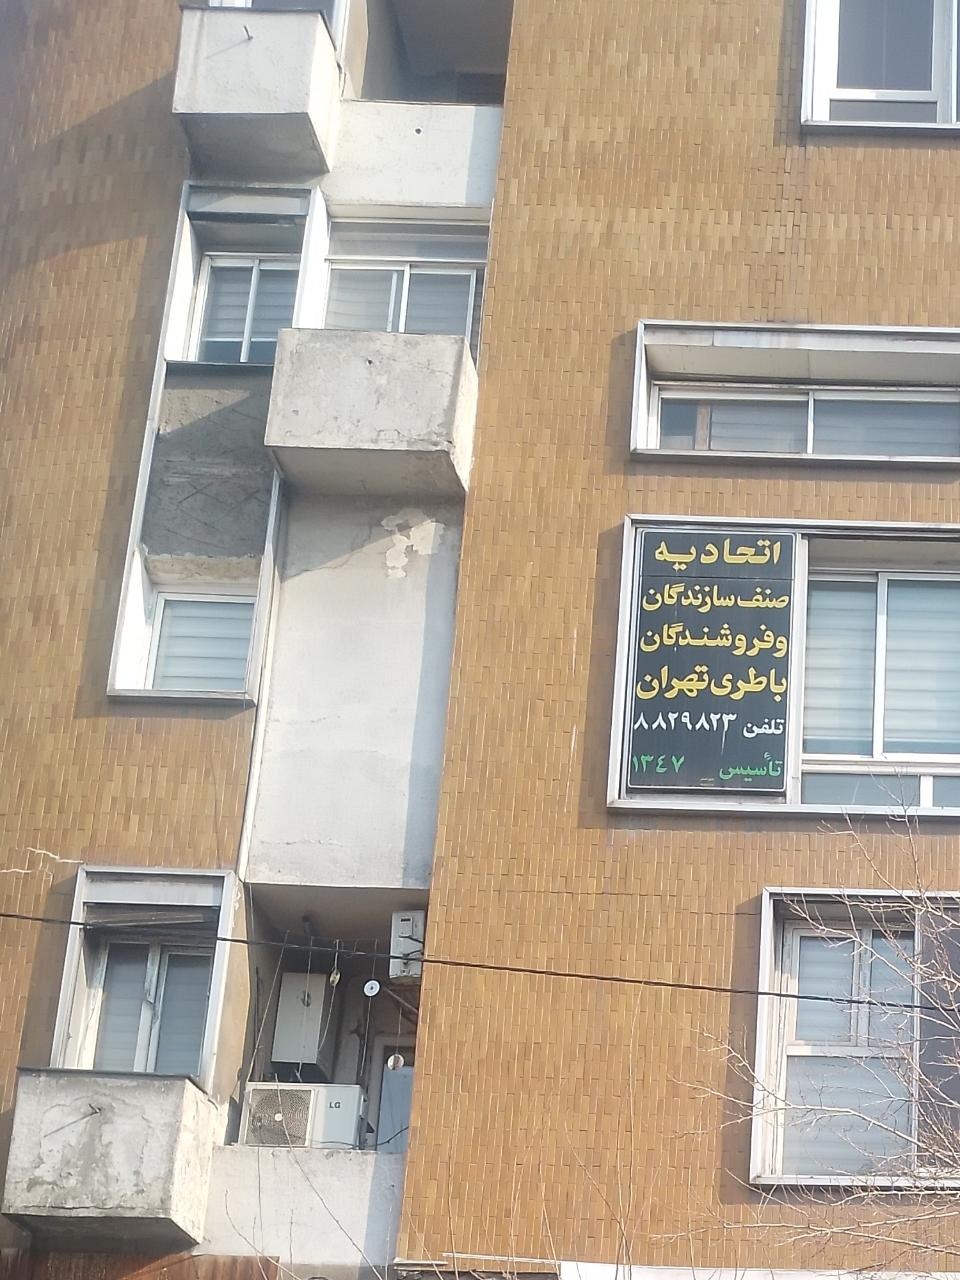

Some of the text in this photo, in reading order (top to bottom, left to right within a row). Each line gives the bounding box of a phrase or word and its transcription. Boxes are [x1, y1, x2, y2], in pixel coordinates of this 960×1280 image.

[654, 538, 781, 571] اتحادیه
[642, 583, 790, 613] صنف سازندگان
[636, 664, 787, 702] باطری تهران
[742, 718, 785, 738] تلفن
[329, 1101, 341, 1109] LG
